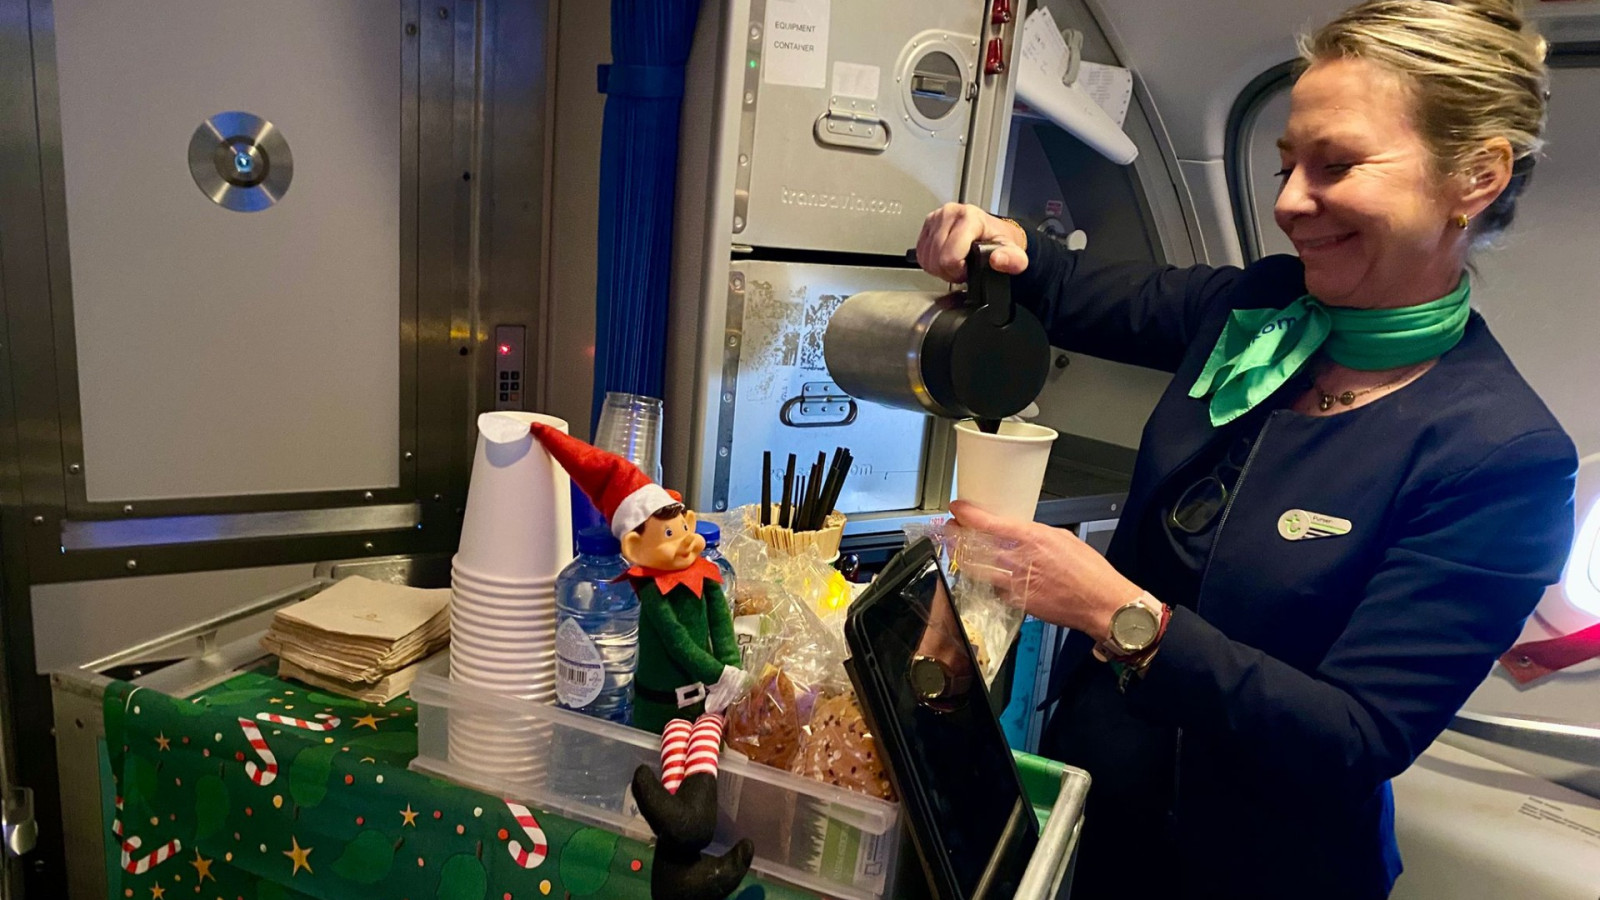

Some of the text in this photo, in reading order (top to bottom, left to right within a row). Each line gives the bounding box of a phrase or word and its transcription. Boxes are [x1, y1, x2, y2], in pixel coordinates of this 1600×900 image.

[775, 21, 815, 32] EQUIPMENT
[774, 41, 814, 52] CONTAINER
[781, 185, 902, 215] transavia.com
